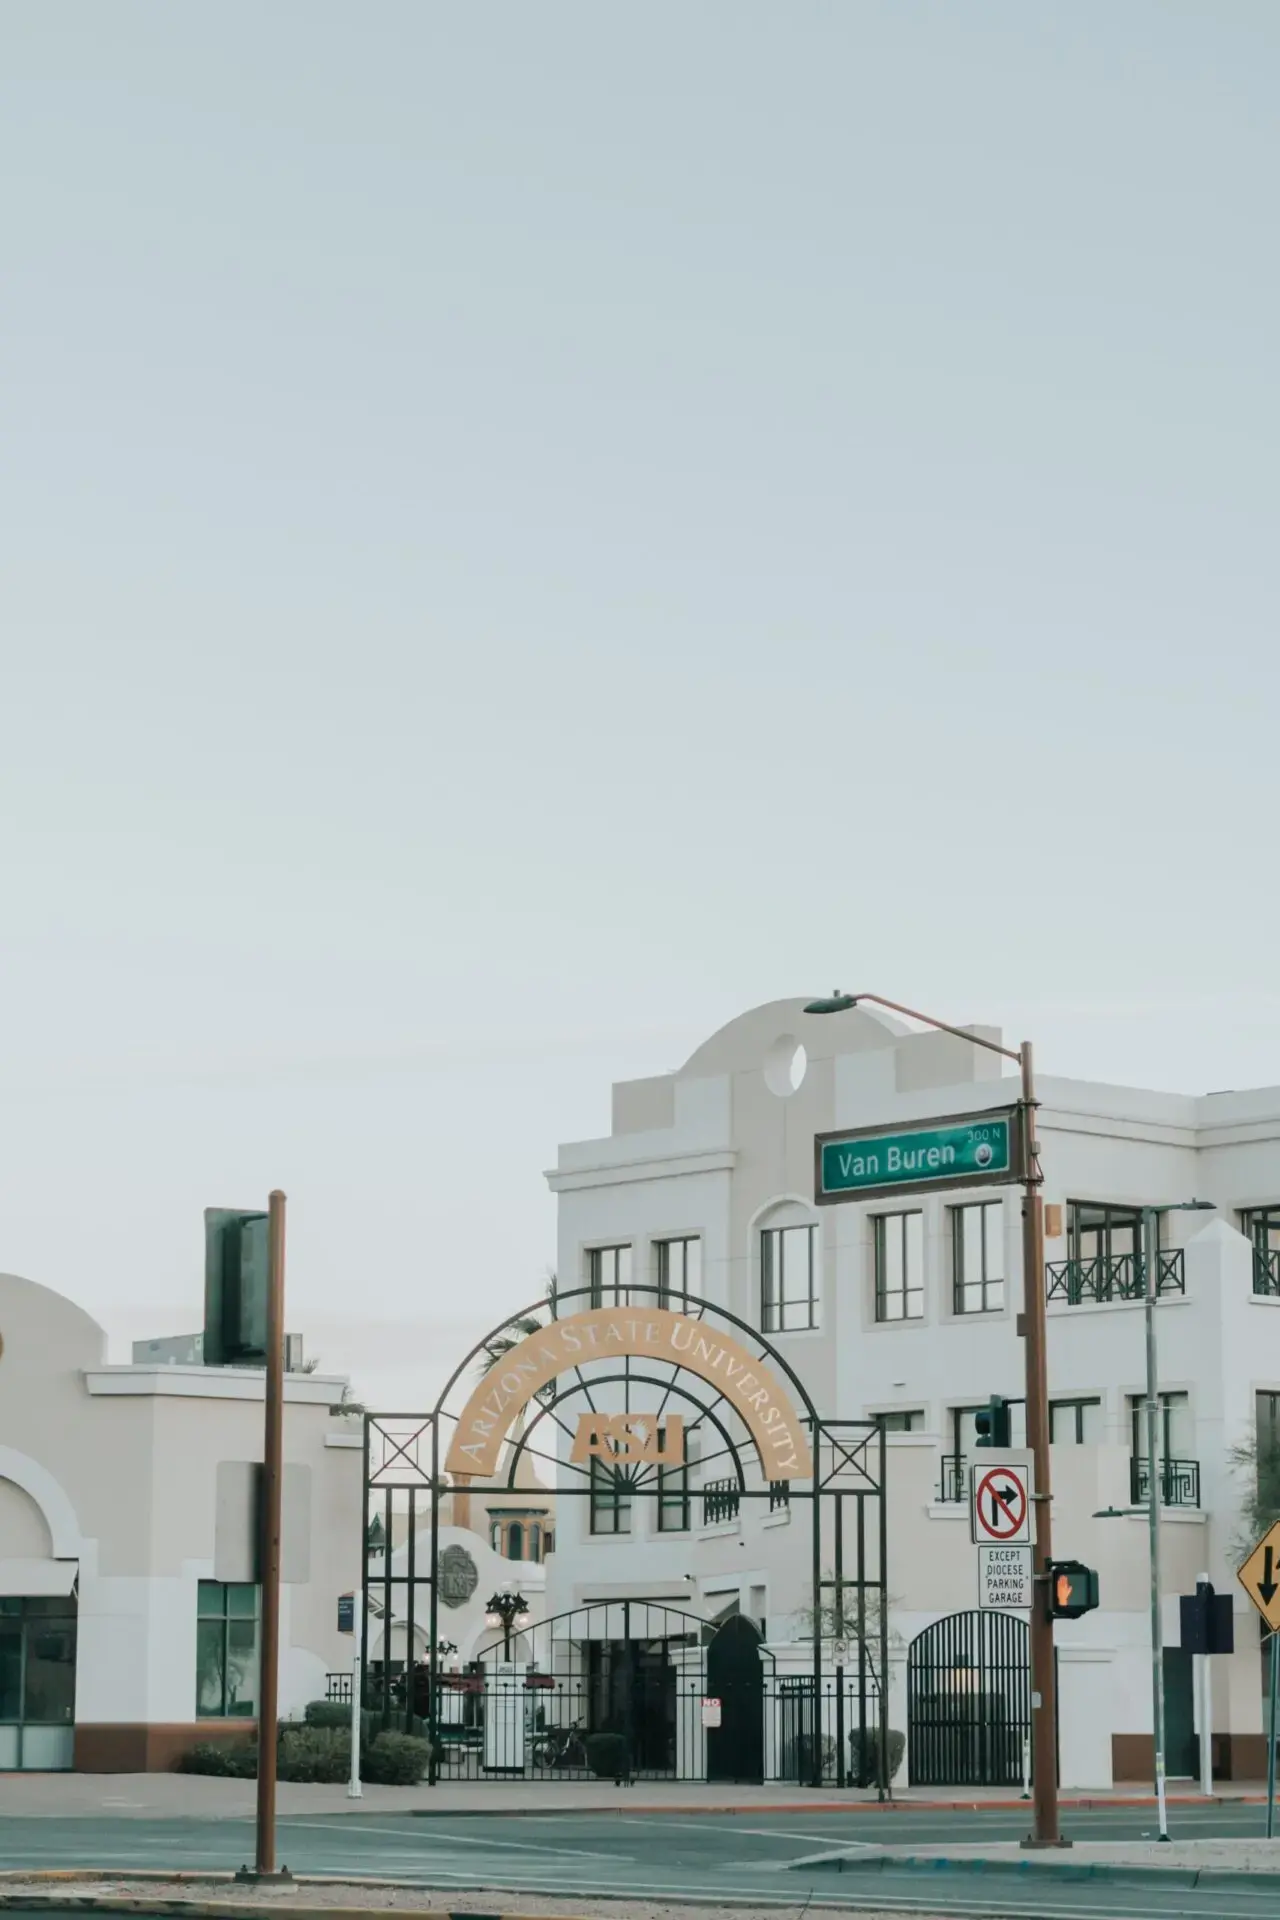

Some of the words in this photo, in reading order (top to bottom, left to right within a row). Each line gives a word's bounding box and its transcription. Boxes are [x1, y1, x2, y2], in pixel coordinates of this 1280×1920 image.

[992, 1127, 1001, 1140] N
[839, 1153, 879, 1178] Van
[887, 1144, 955, 1172] Buren
[459, 1347, 557, 1464] ARIZONA
[560, 1319, 661, 1352] STATE
[670, 1321, 799, 1470] UNIVERSITY
[569, 1413, 685, 1465] ASU
[989, 1551, 1020, 1561] EXCEPT
[987, 1564, 1023, 1575] DIOCESE
[987, 1578, 1024, 1589] PARKING
[989, 1592, 1023, 1603] GARAGE
[702, 1698, 721, 1707] NO
